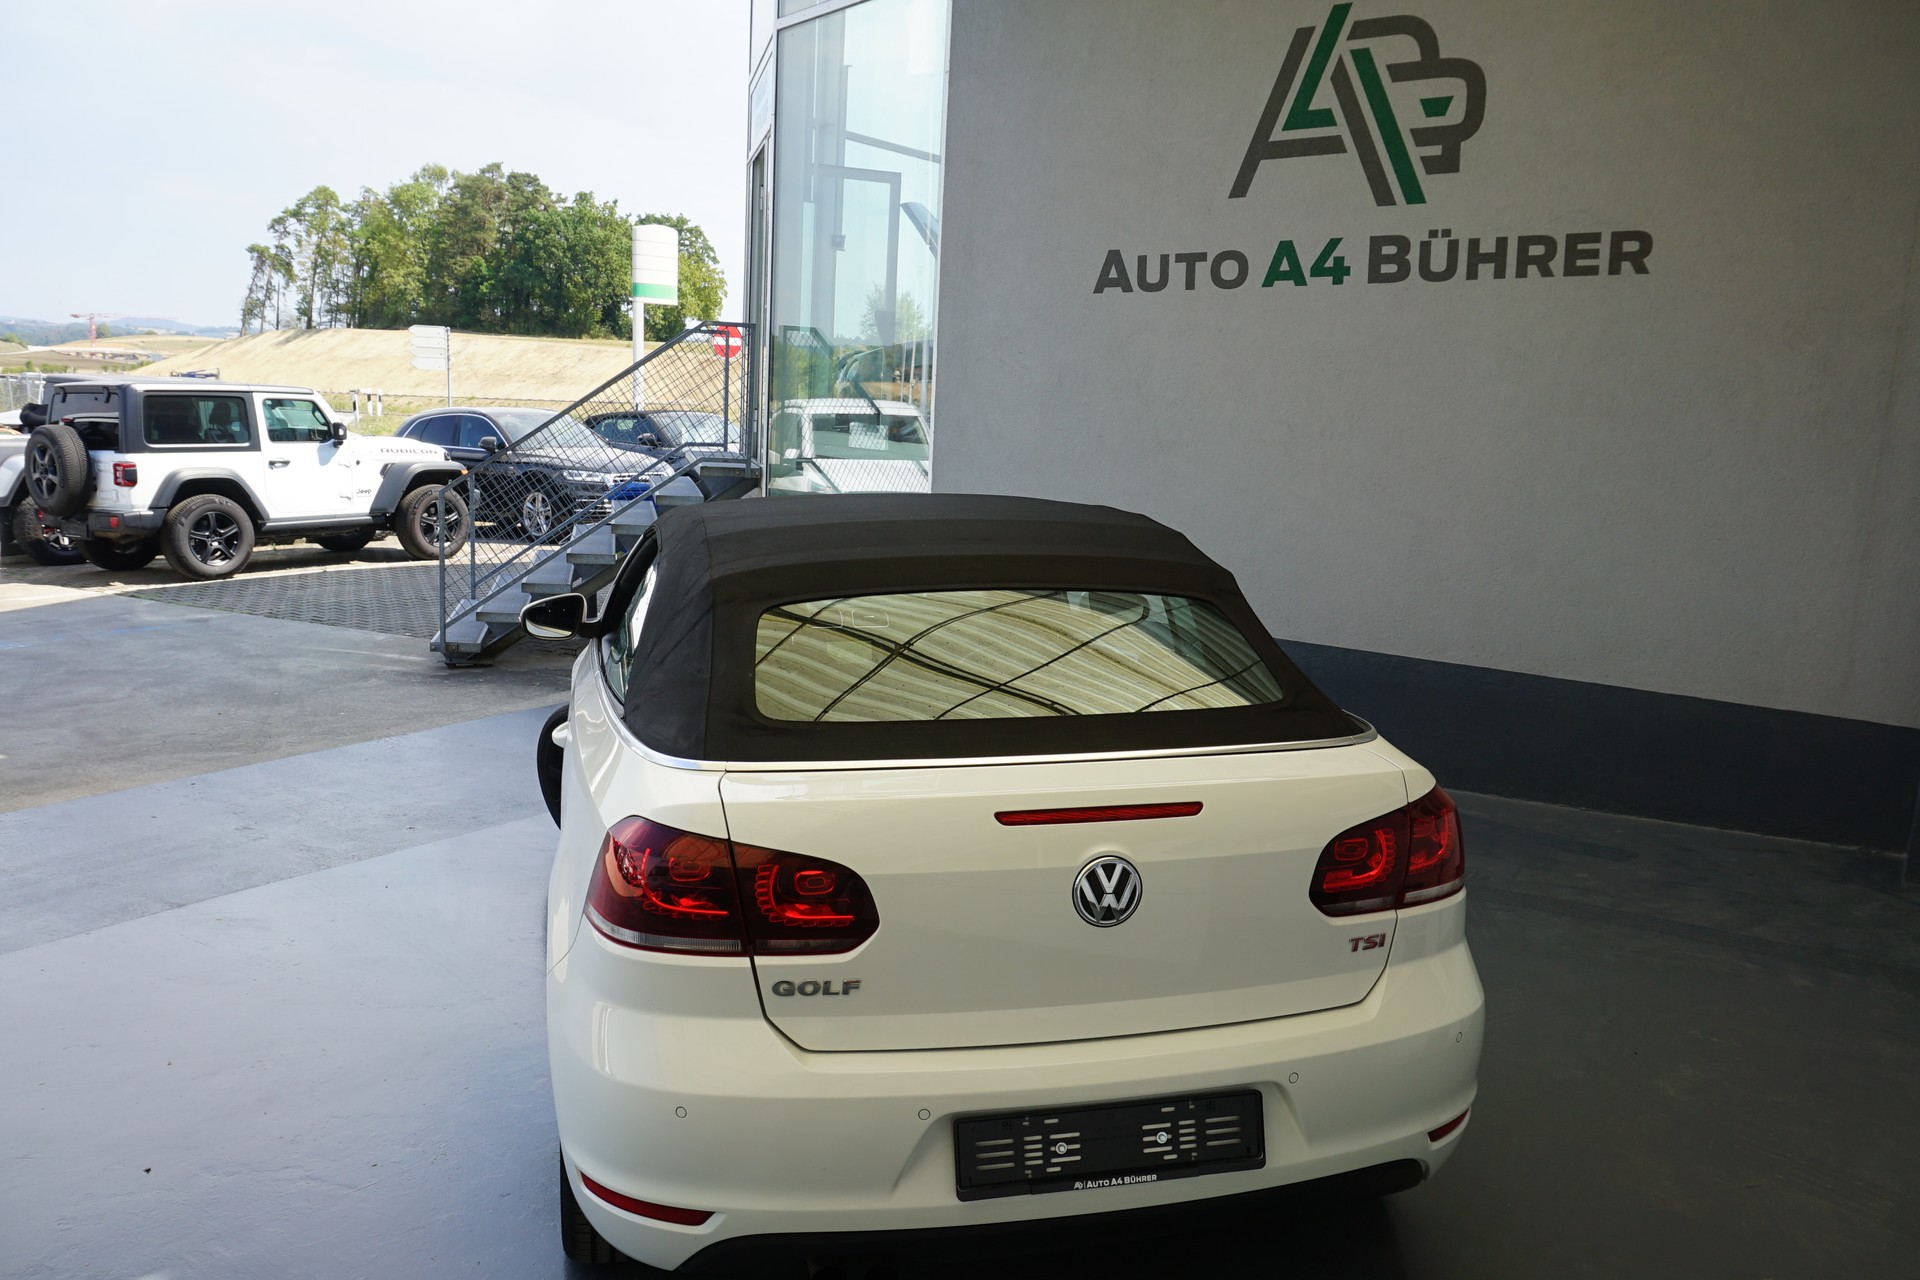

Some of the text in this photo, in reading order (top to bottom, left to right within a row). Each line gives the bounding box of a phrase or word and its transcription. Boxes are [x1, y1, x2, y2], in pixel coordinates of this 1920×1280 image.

[1093, 228, 1654, 294] AUTO A4 BÜHRER
[380, 447, 438, 455] RUBICON
[1077, 859, 1140, 924] VW
[1349, 933, 1386, 952] TSI
[772, 980, 861, 997] GOLF
[1086, 1179, 1110, 1189] AUTO
[1110, 1177, 1123, 1186] A4
[1123, 1174, 1157, 1184] BÜHRER
